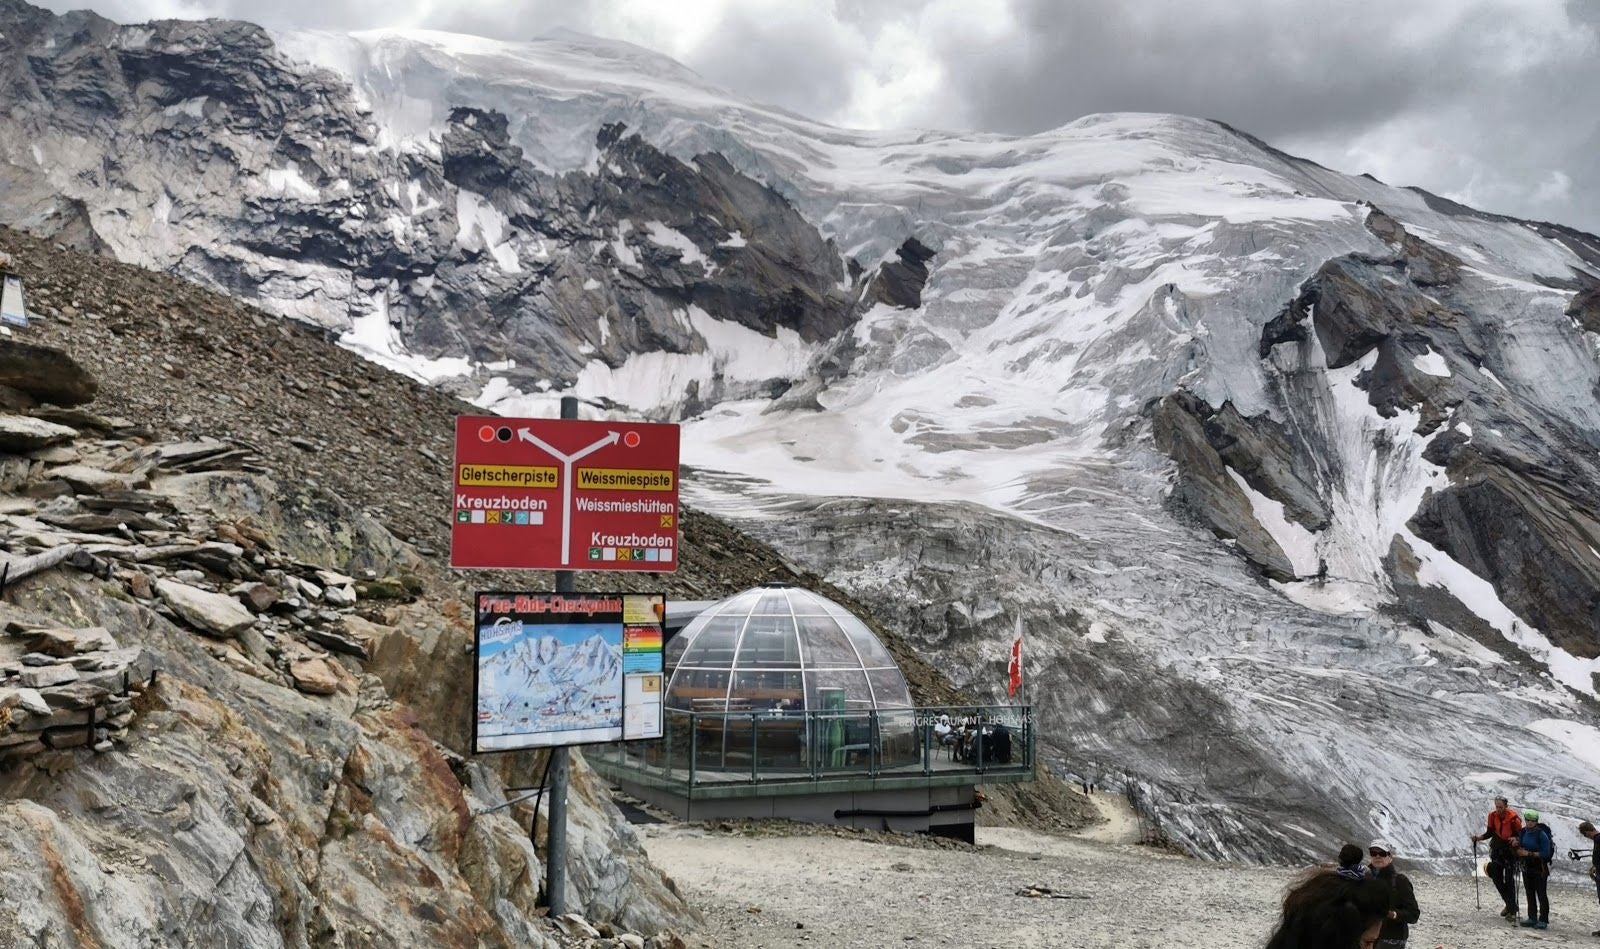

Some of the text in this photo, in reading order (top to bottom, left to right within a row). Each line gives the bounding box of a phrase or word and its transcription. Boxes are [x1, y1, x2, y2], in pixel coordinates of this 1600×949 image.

[461, 467, 556, 485] Gletscherpiste
[580, 471, 670, 488] Weissmiespiste
[456, 494, 548, 510] Kreuzboden
[575, 497, 674, 513] Weissmieshütten
[591, 531, 673, 547] Kreuzboden
